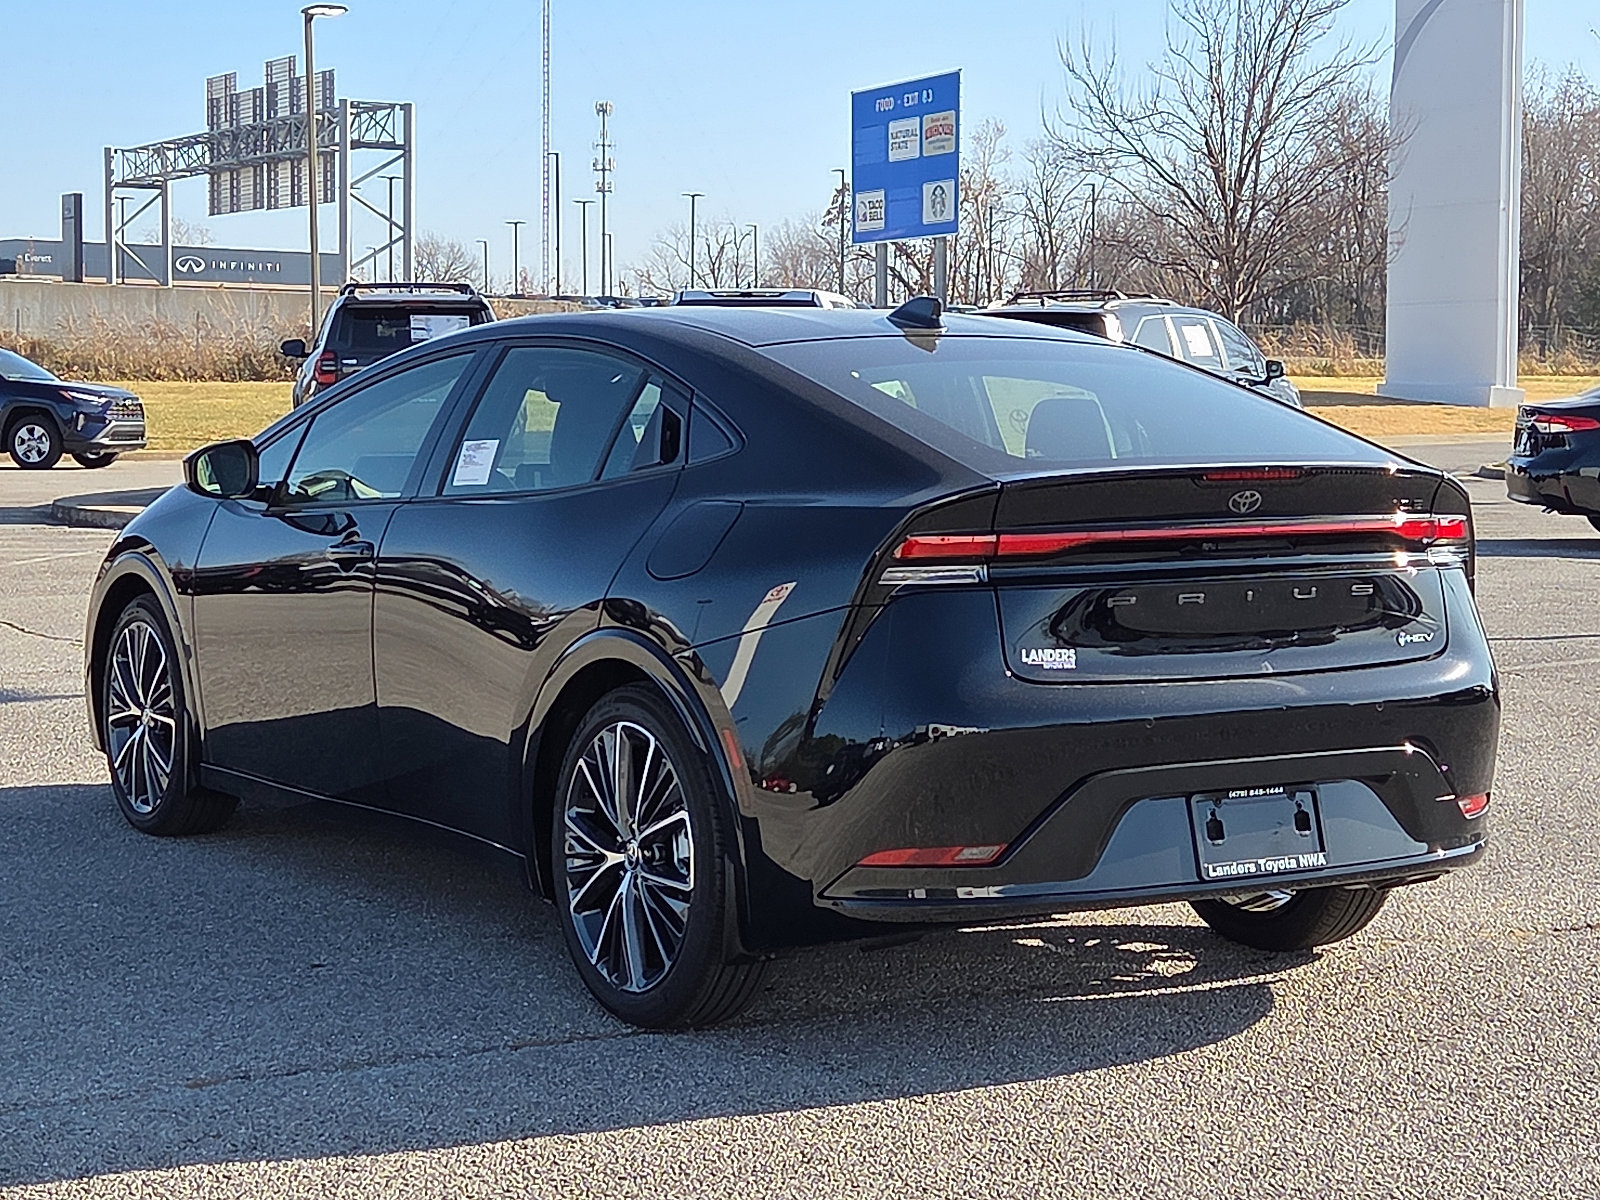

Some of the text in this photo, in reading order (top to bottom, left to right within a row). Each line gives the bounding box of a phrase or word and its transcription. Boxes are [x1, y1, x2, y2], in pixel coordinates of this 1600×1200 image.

[875, 97, 895, 112] FOOD
[903, 92, 919, 107] EXIT
[890, 128, 918, 140] NATURAL
[890, 140, 909, 152] STATE
[867, 199, 884, 210] TACO
[868, 209, 884, 222] BELL
[211, 260, 281, 272] INFINITI
[1021, 648, 1077, 663] LANDERS
[1207, 852, 1327, 878] Landers Toyota NWA
